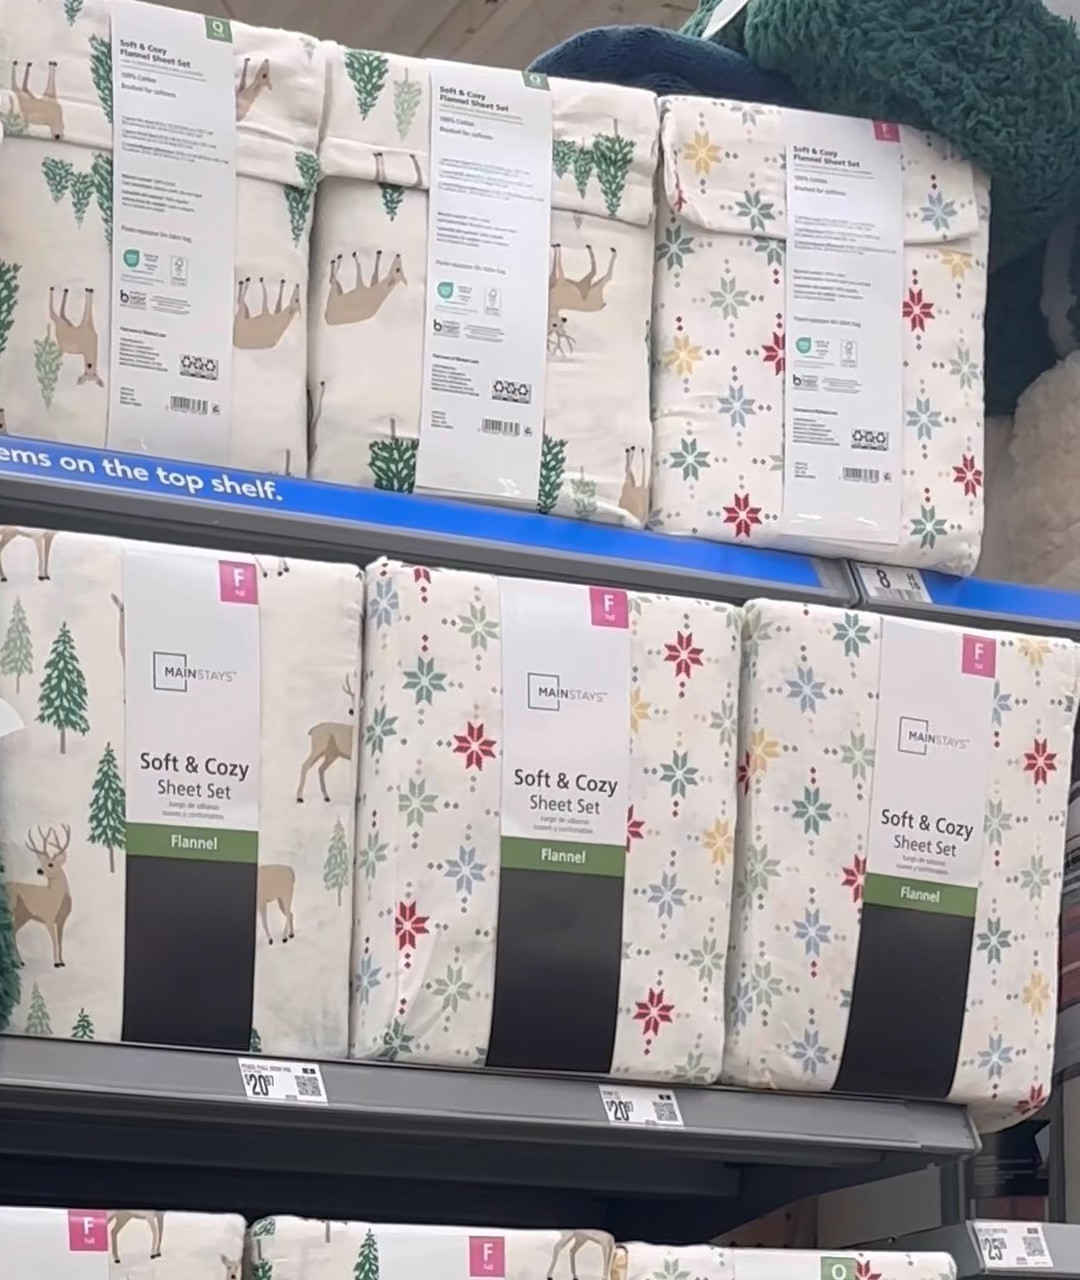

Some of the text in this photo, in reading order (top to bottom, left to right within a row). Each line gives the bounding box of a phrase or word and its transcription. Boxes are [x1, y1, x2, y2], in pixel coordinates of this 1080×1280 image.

[59, 455, 95, 474] on
[102, 458, 149, 482] the
[156, 465, 204, 495] top
[211, 474, 284, 501] shelf.
[234, 568, 245, 587] F
[876, 569, 891, 589] 8
[604, 594, 614, 612] F
[975, 643, 984, 660] F
[165, 666, 233, 682] MAINSTAYS
[539, 687, 604, 702] MAINSTAYS
[140, 752, 249, 782] Soft & Cozy
[158, 779, 231, 800] Sheet Set
[514, 768, 618, 798] Soft & Cozy
[530, 794, 600, 815] Sheet Set
[881, 808, 974, 841] Soft & Cozy
[170, 834, 218, 850] Flannel
[894, 834, 957, 857] Sheet Set
[541, 848, 586, 864] Flannel
[900, 886, 940, 903] Flannel
[83, 1217, 94, 1234] F
[484, 1243, 493, 1261] F
